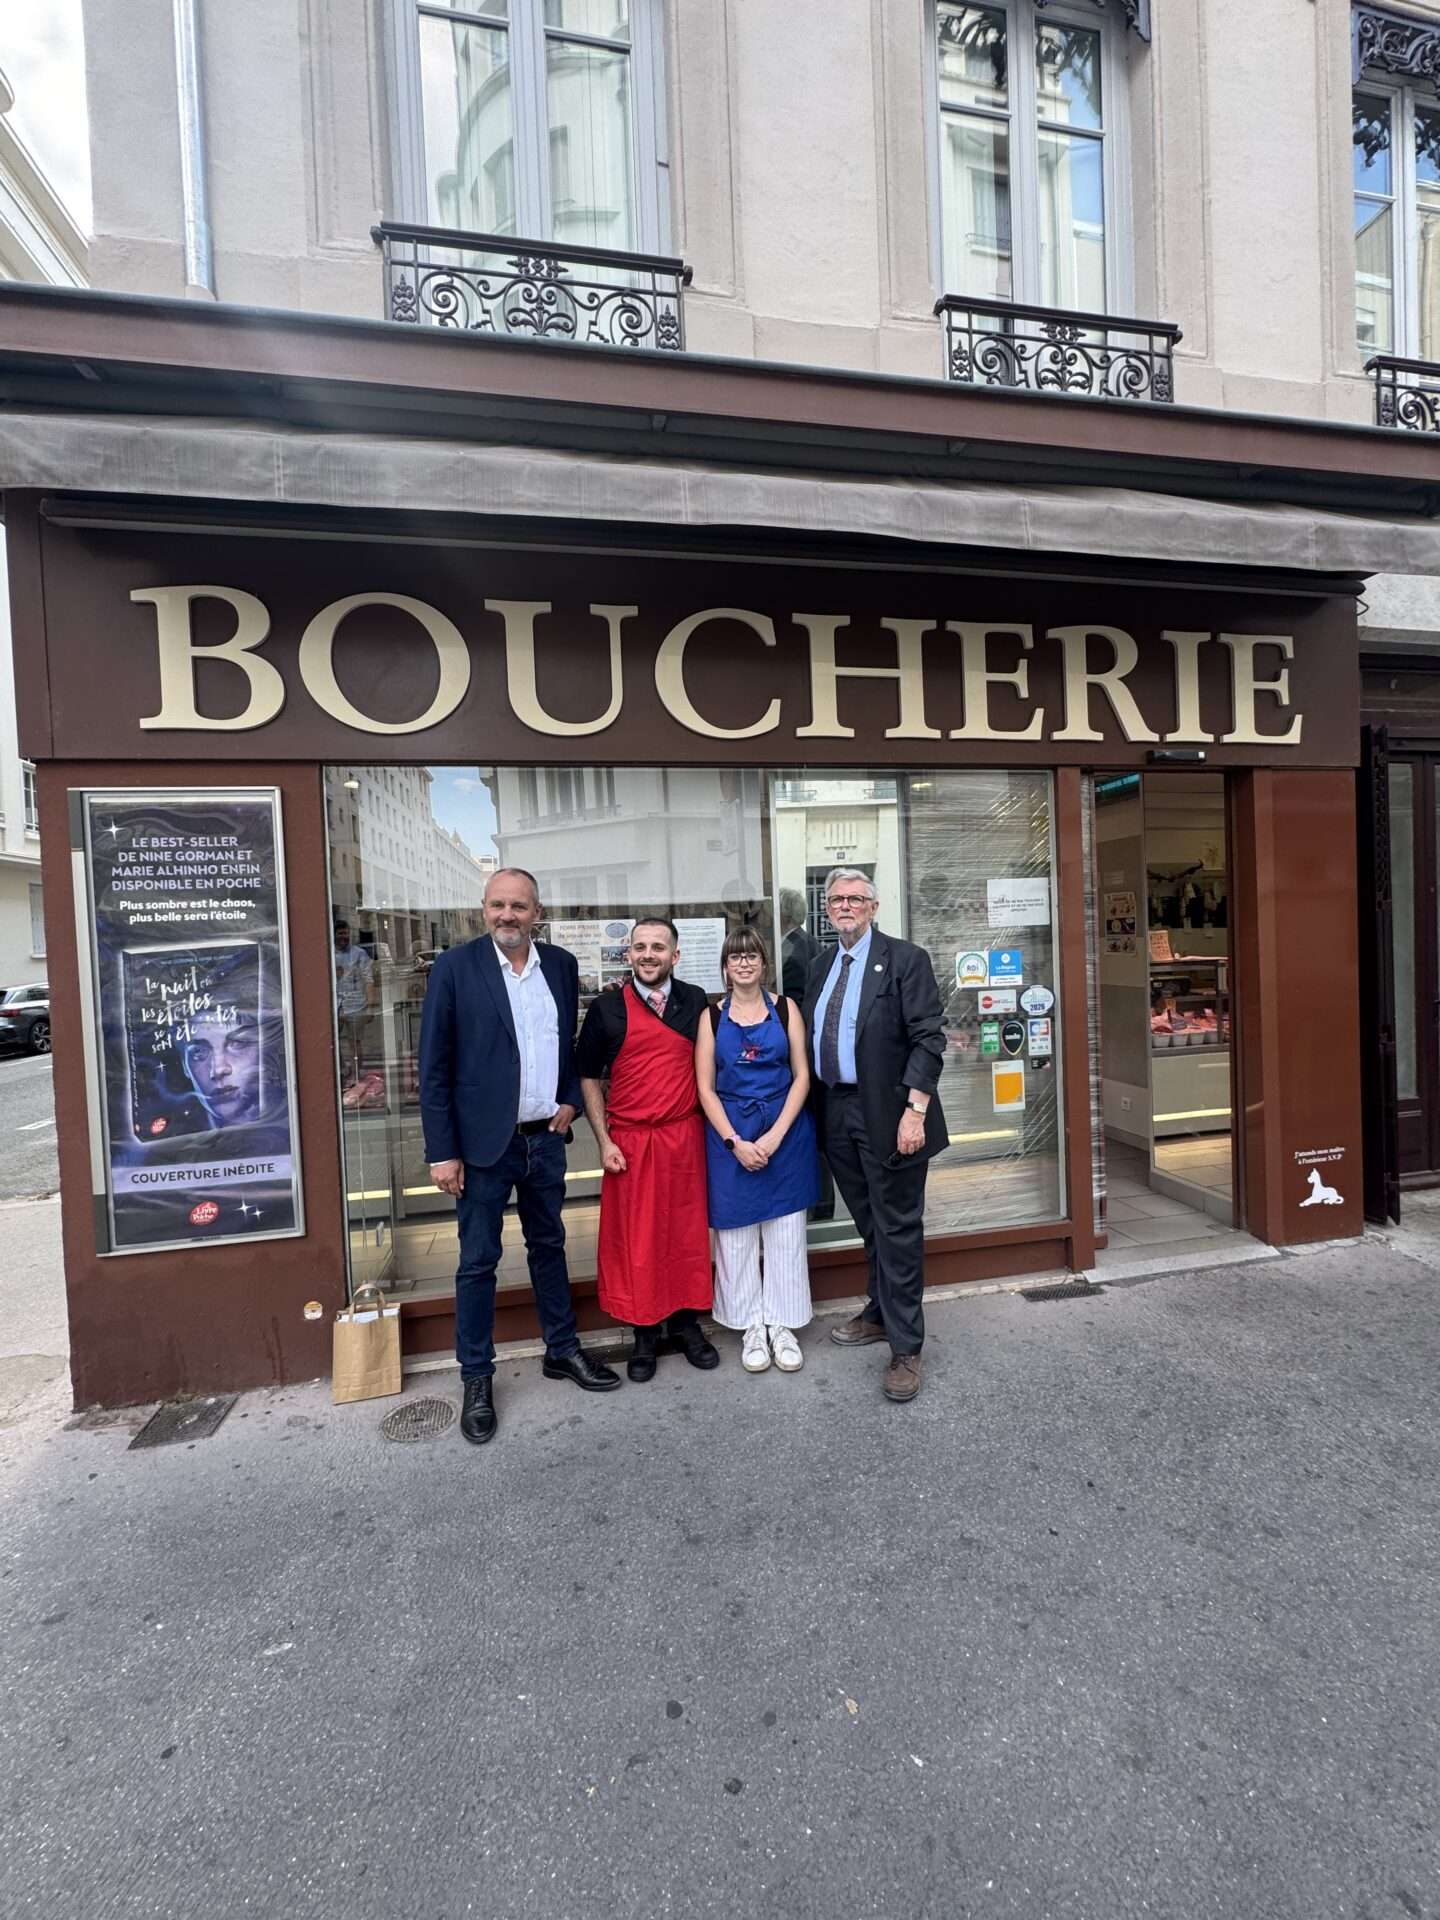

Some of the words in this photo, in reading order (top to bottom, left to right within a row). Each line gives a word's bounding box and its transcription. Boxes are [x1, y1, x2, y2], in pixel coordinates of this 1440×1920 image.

[130, 585, 1304, 745] BOUCHERIE
[132, 837, 148, 848] LE
[151, 836, 239, 847] BEST-SELLER
[118, 851, 136, 862] DE
[139, 850, 173, 861] NINE
[175, 850, 235, 861] GORMAN
[237, 849, 253, 860] ET
[112, 865, 156, 876] MARIE
[158, 864, 219, 875] ALHINHO
[221, 864, 261, 874] ENFIN
[112, 879, 193, 890] DISPONIBLE
[195, 879, 214, 889] EN
[217, 878, 261, 889] POCHE
[119, 900, 144, 910] Plus
[146, 899, 187, 910] sombre
[190, 900, 207, 909] est
[209, 899, 219, 909] le
[221, 899, 256, 909] chaos,
[129, 913, 153, 924] plus
[155, 912, 182, 922] belle
[184, 912, 208, 921] sera
[210, 910, 246, 920] l'étoile
[146, 978, 160, 995] La
[160, 966, 198, 1000] nuit
[157, 992, 213, 1025] étoiles
[131, 1168, 221, 1184] COUVERTURE
[223, 1162, 275, 1177] INÉDITE
